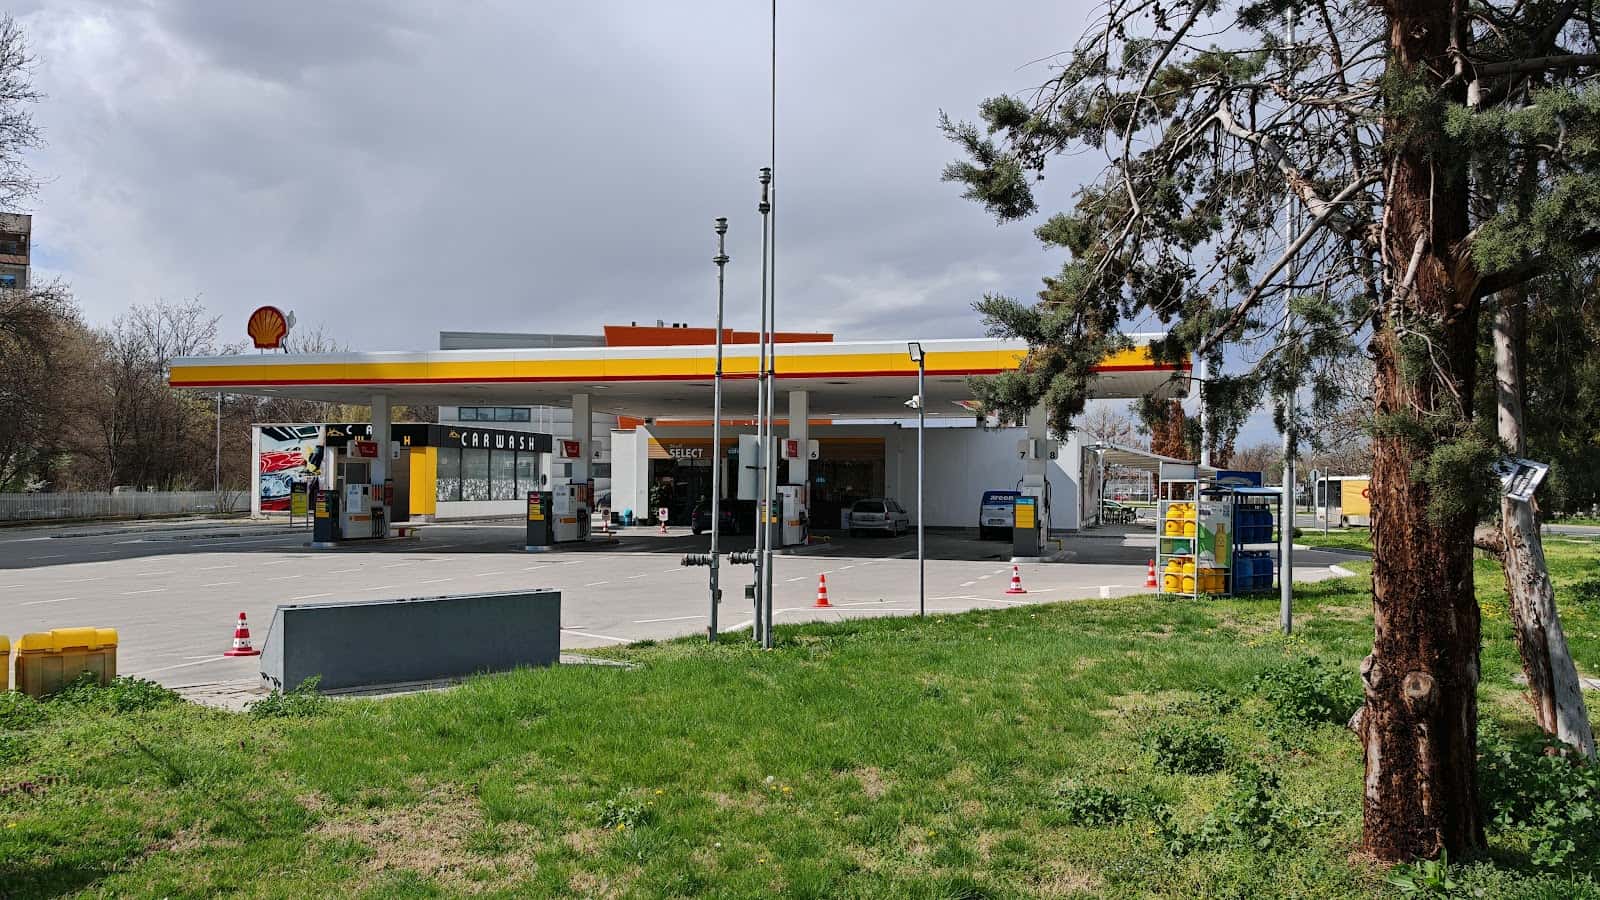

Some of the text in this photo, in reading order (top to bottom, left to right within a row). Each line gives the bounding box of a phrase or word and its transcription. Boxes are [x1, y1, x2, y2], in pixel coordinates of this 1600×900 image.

[670, 448, 704, 458] SELECT
[1019, 451, 1026, 459] 7
[1049, 451, 1056, 459] 8
